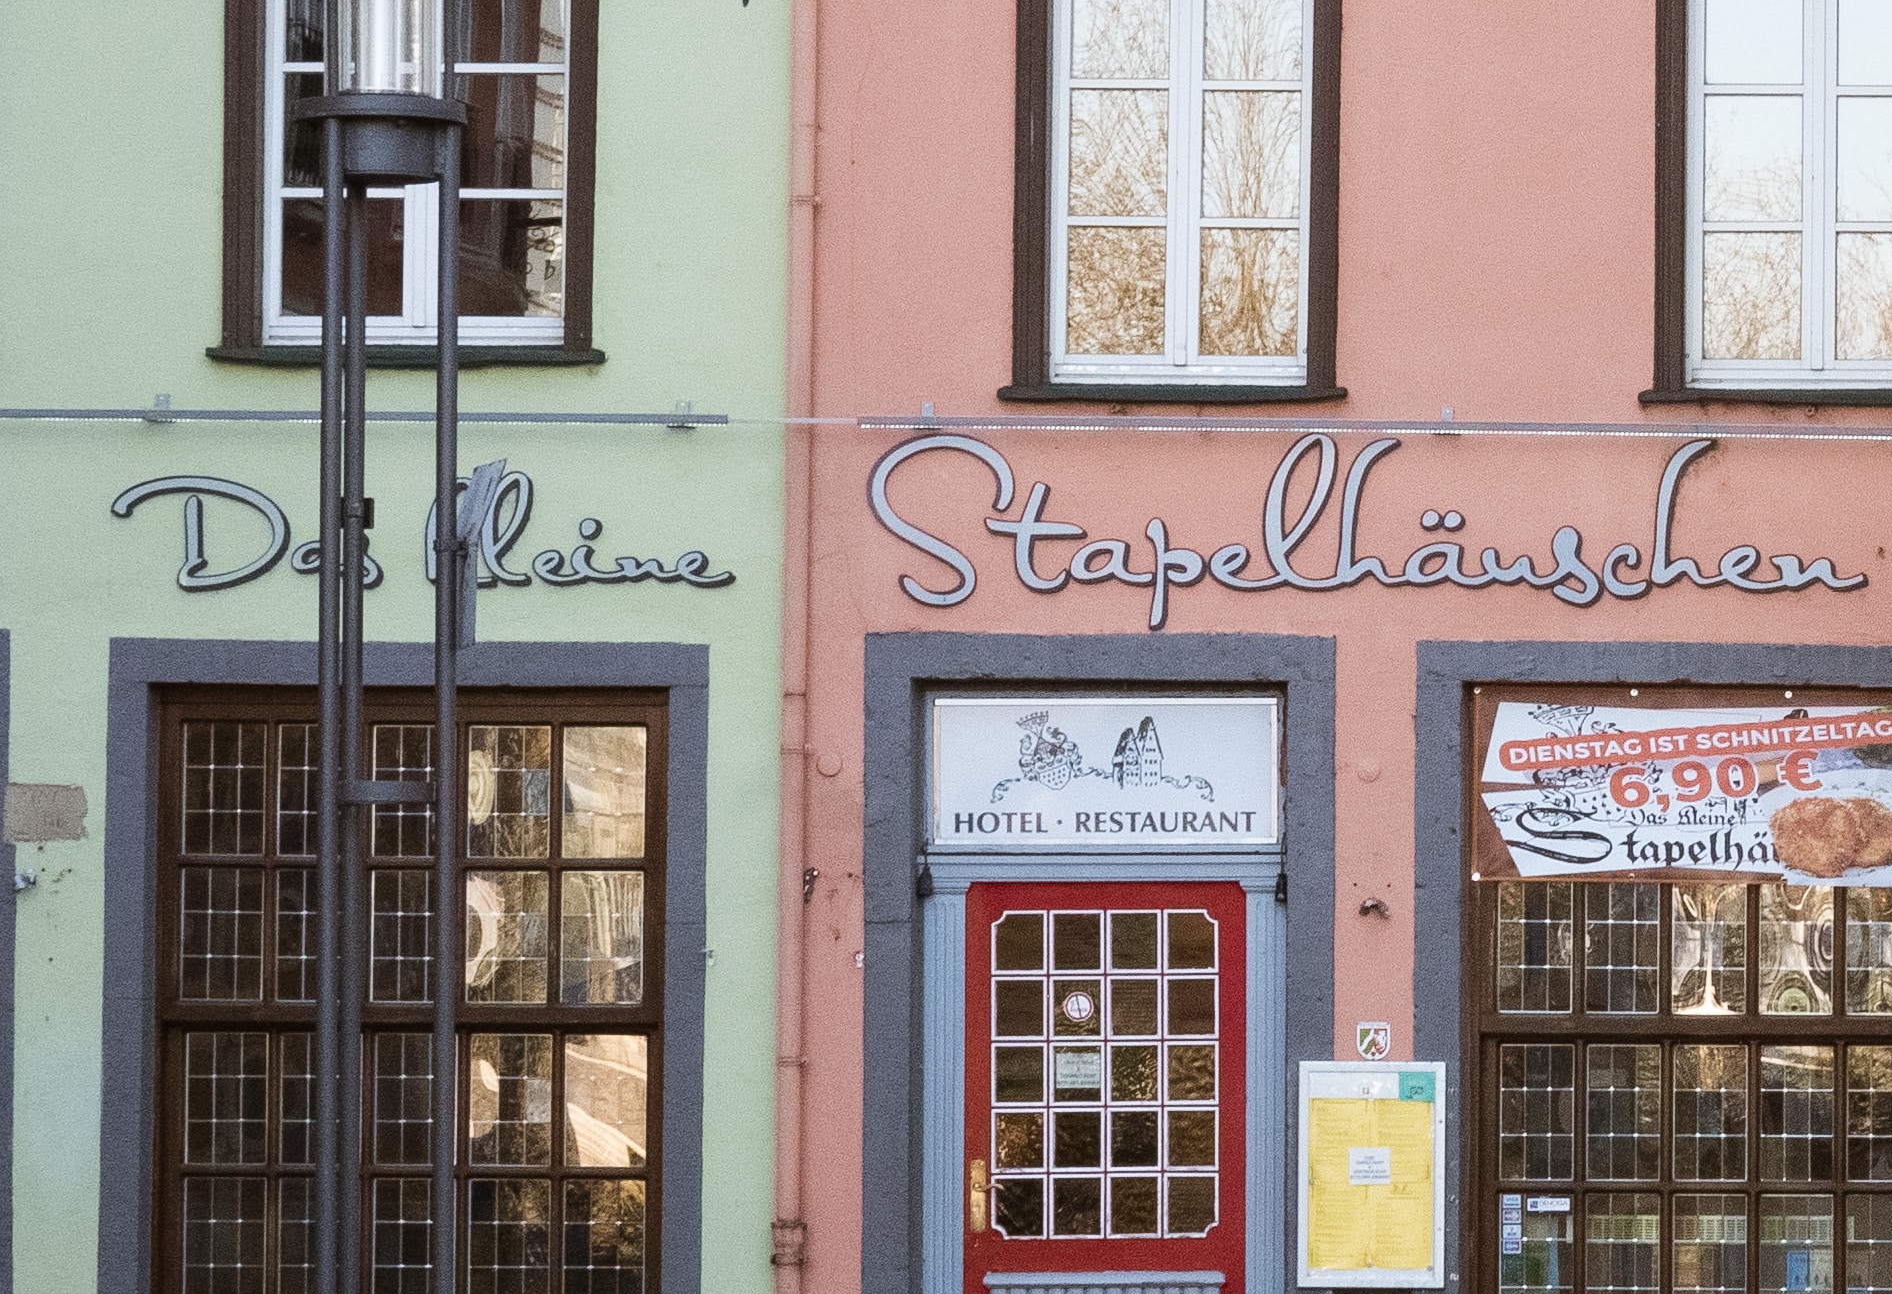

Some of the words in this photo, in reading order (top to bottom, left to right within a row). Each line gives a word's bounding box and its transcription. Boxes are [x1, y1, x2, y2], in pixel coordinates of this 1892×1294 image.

[866, 433, 1868, 631] Stapelhäuschen
[1507, 736, 1643, 766] DIENSTAG
[1649, 735, 1687, 753] IST
[1608, 755, 1757, 813] 6,90
[1779, 748, 1824, 792] €
[953, 811, 1049, 835] HOTEL
[1074, 811, 1257, 835] RESTAURANT
[1624, 807, 1668, 827] Das
